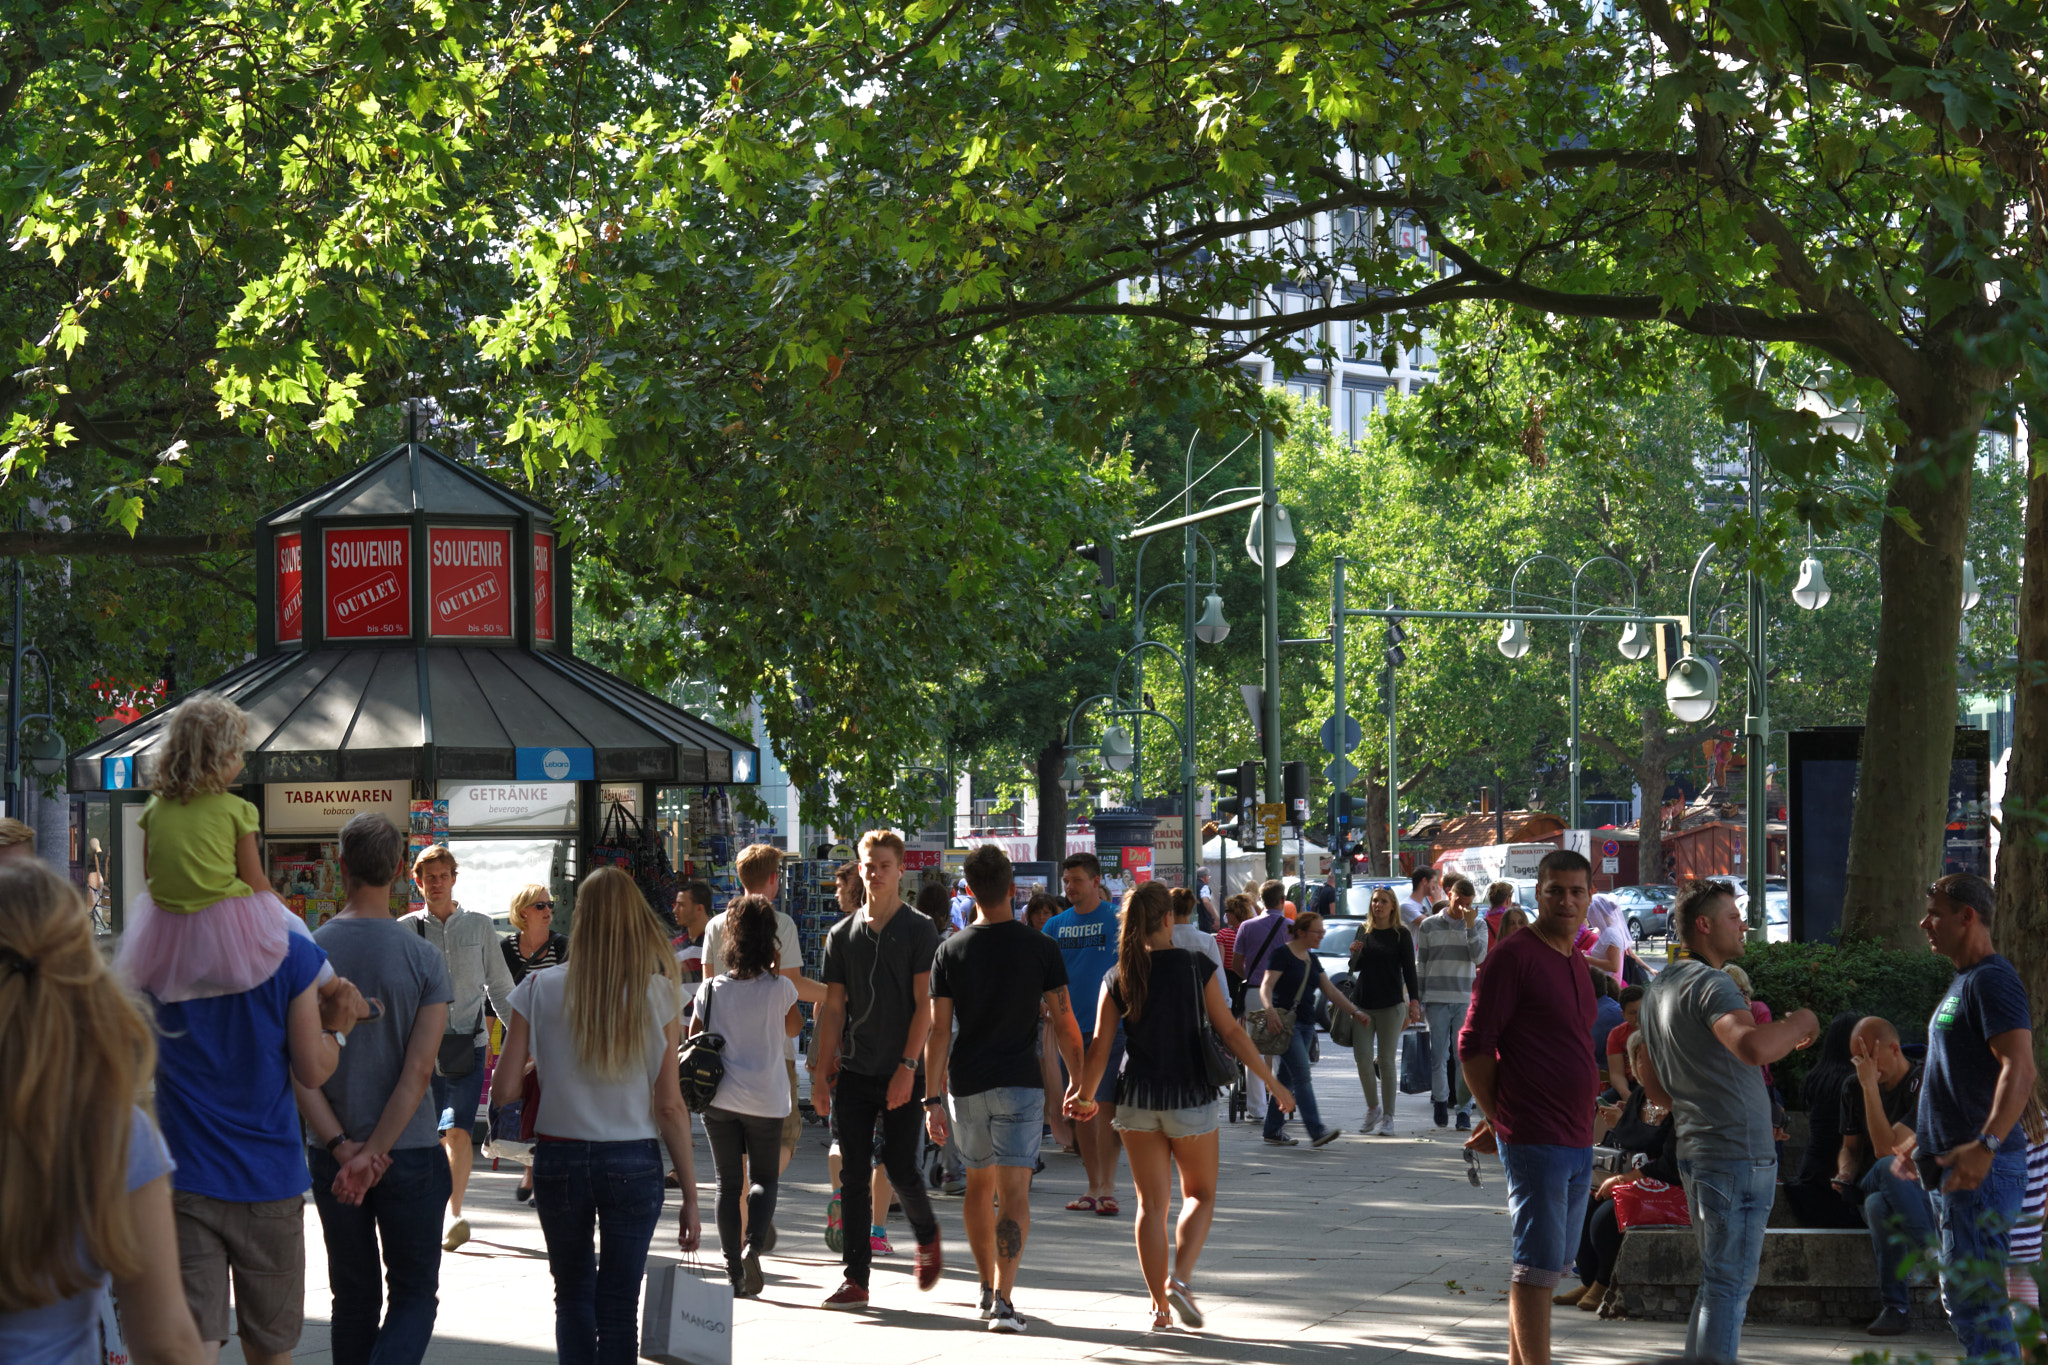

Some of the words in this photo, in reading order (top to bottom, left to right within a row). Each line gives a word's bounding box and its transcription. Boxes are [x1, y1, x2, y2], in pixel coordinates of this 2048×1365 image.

[280, 545, 302, 574] SOUVE
[330, 540, 403, 568] SOUVENIR
[433, 540, 503, 567] SOUVENIR
[284, 588, 302, 621] OUTL
[337, 577, 396, 617] OUTLET
[440, 577, 496, 616] OUTLET
[367, 624, 379, 633] bis
[380, 624, 394, 632] -50
[468, 624, 480, 632] bis
[481, 624, 494, 632] -50
[544, 760, 569, 768] Lebara
[285, 789, 392, 804] TABAKWAREN
[469, 785, 548, 801] GETRÄNKE
[323, 806, 355, 816] tobacco
[488, 804, 529, 815] beverages
[1154, 829, 1183, 839] ERLINE
[1058, 922, 1104, 938] PROTECT
[681, 1309, 726, 1334] MANGO
